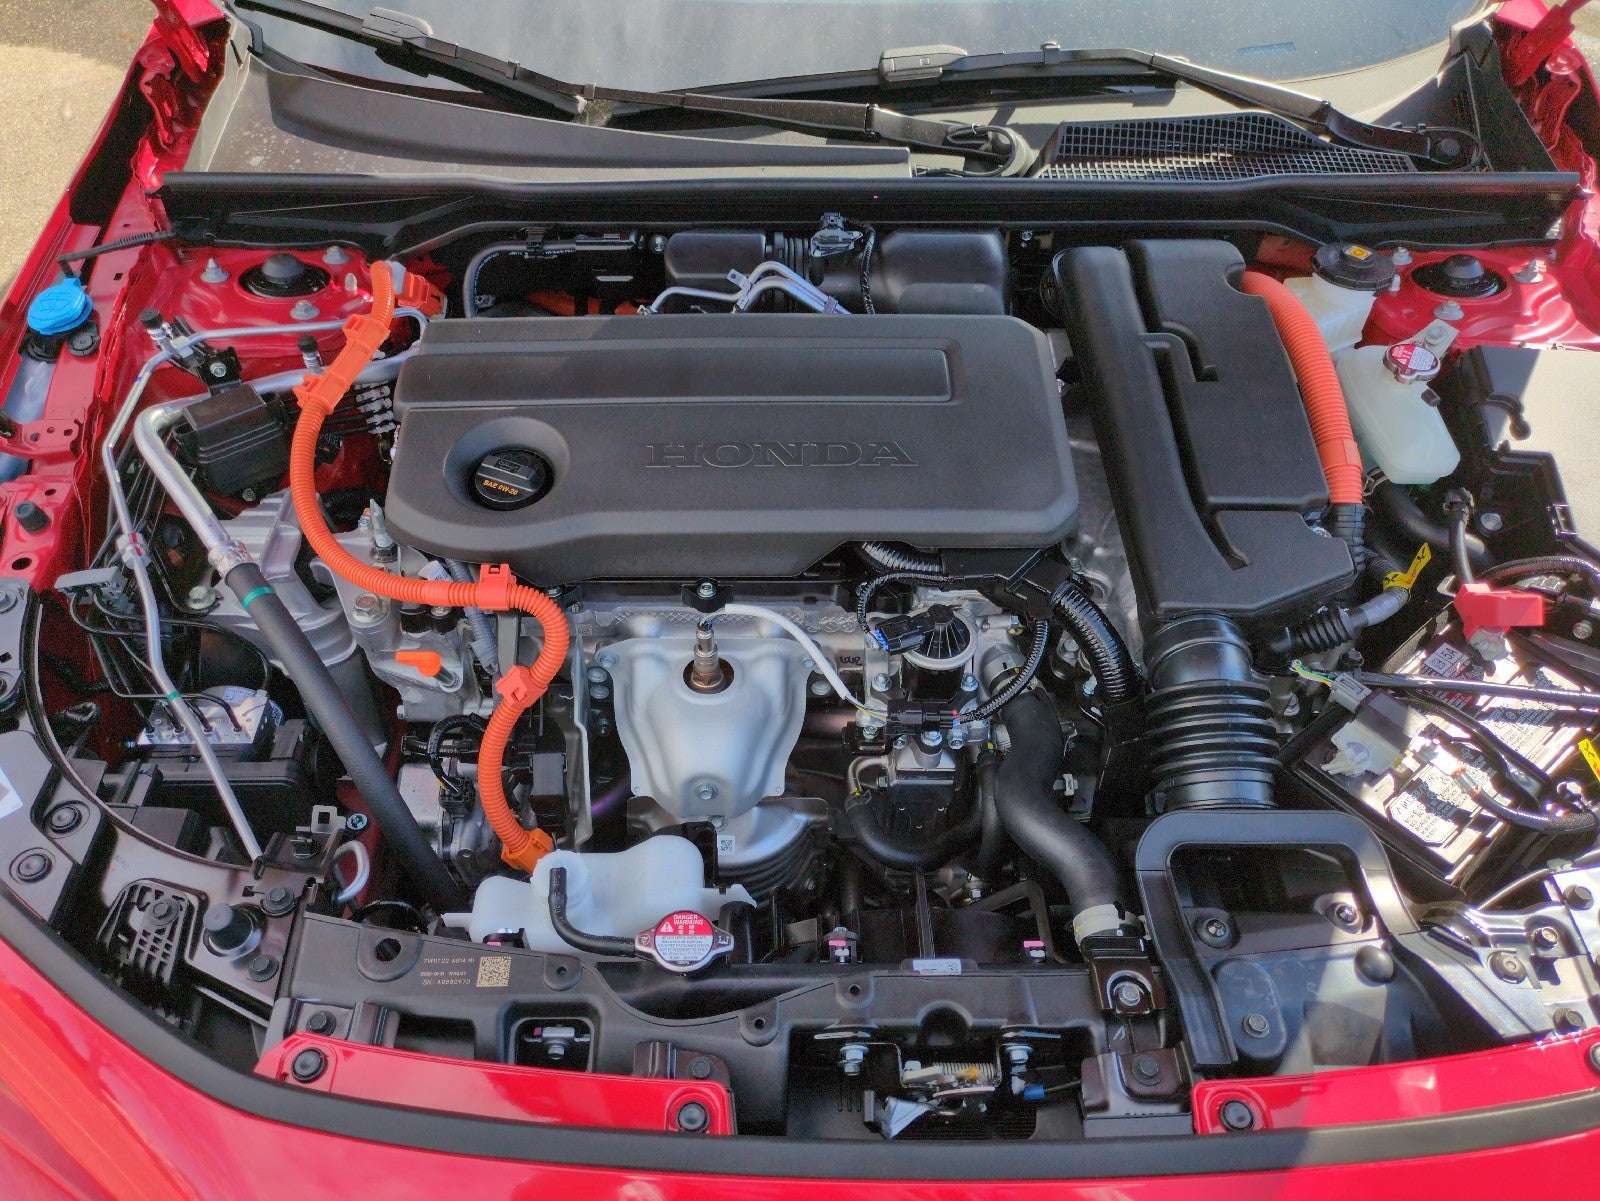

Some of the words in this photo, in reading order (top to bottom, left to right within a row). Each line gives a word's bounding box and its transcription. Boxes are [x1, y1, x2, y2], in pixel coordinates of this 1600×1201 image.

[645, 441, 919, 468] HONDA
[483, 480, 498, 489] SAE
[498, 486, 519, 495] 0W-20
